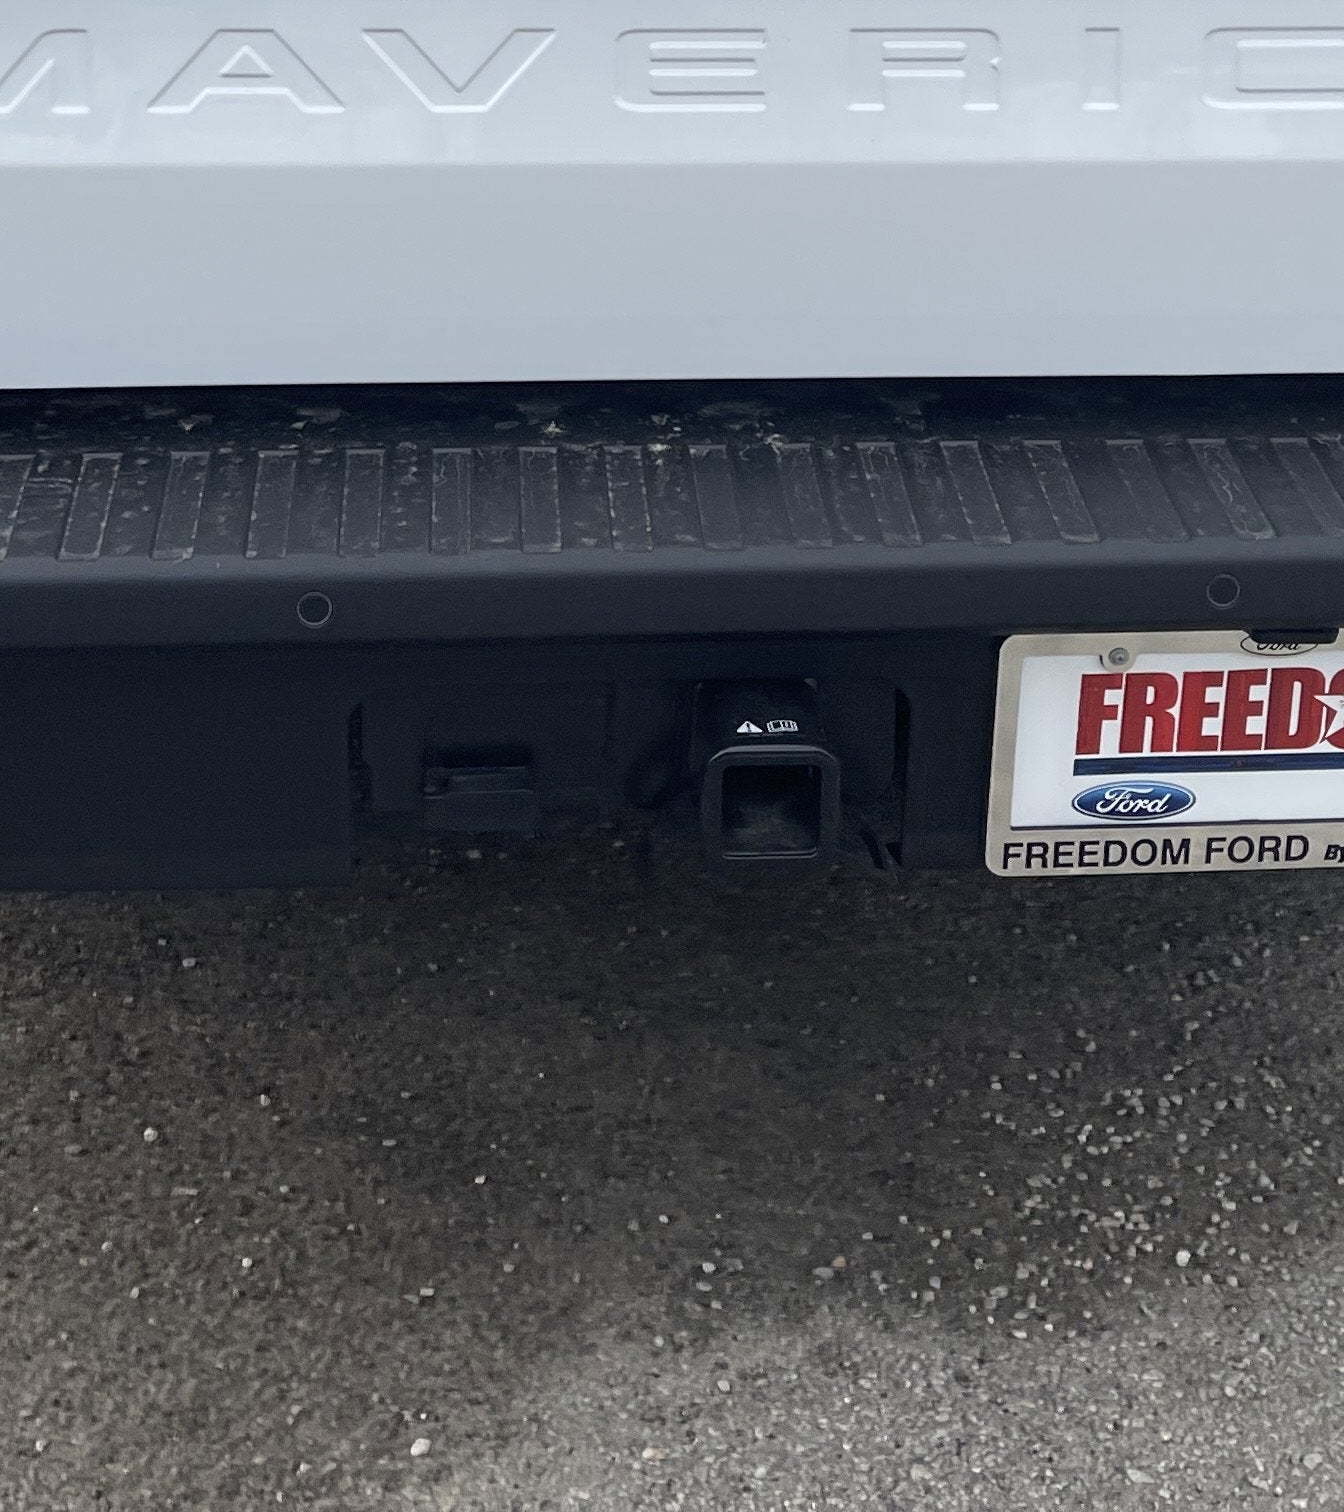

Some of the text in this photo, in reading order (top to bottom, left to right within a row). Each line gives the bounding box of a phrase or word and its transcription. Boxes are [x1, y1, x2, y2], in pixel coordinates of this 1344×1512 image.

[1096, 787, 1171, 813] Ford
[1003, 838, 1191, 870] FREEDOM
[1205, 835, 1310, 865] FORD
